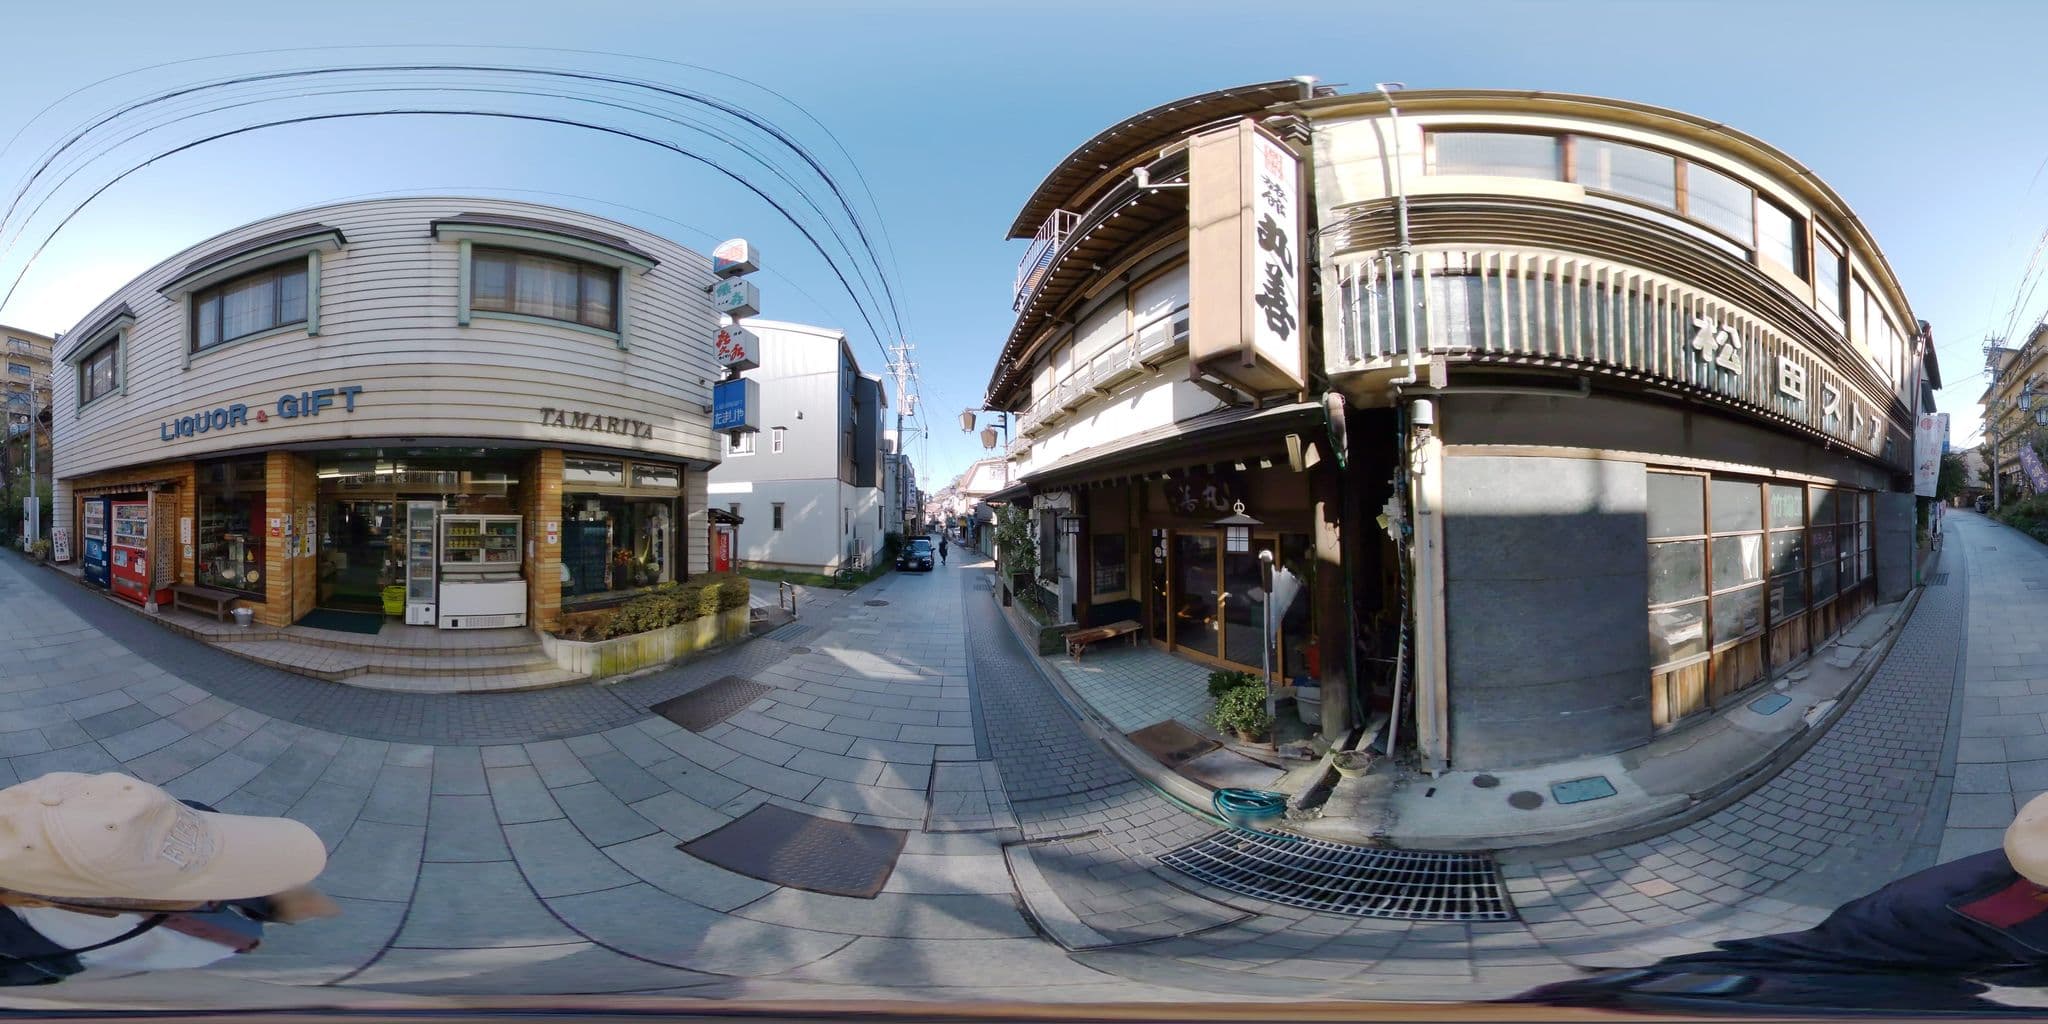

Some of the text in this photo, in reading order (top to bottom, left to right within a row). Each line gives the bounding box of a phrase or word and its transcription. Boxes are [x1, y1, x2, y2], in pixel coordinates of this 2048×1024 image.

[1255, 212, 1296, 342] 丸善
[1692, 315, 1882, 442] 松田ストア
[160, 384, 363, 442] LIQUOR & GIFT
[540, 407, 653, 440] TAMARIYA
[714, 407, 745, 425] たまりや
